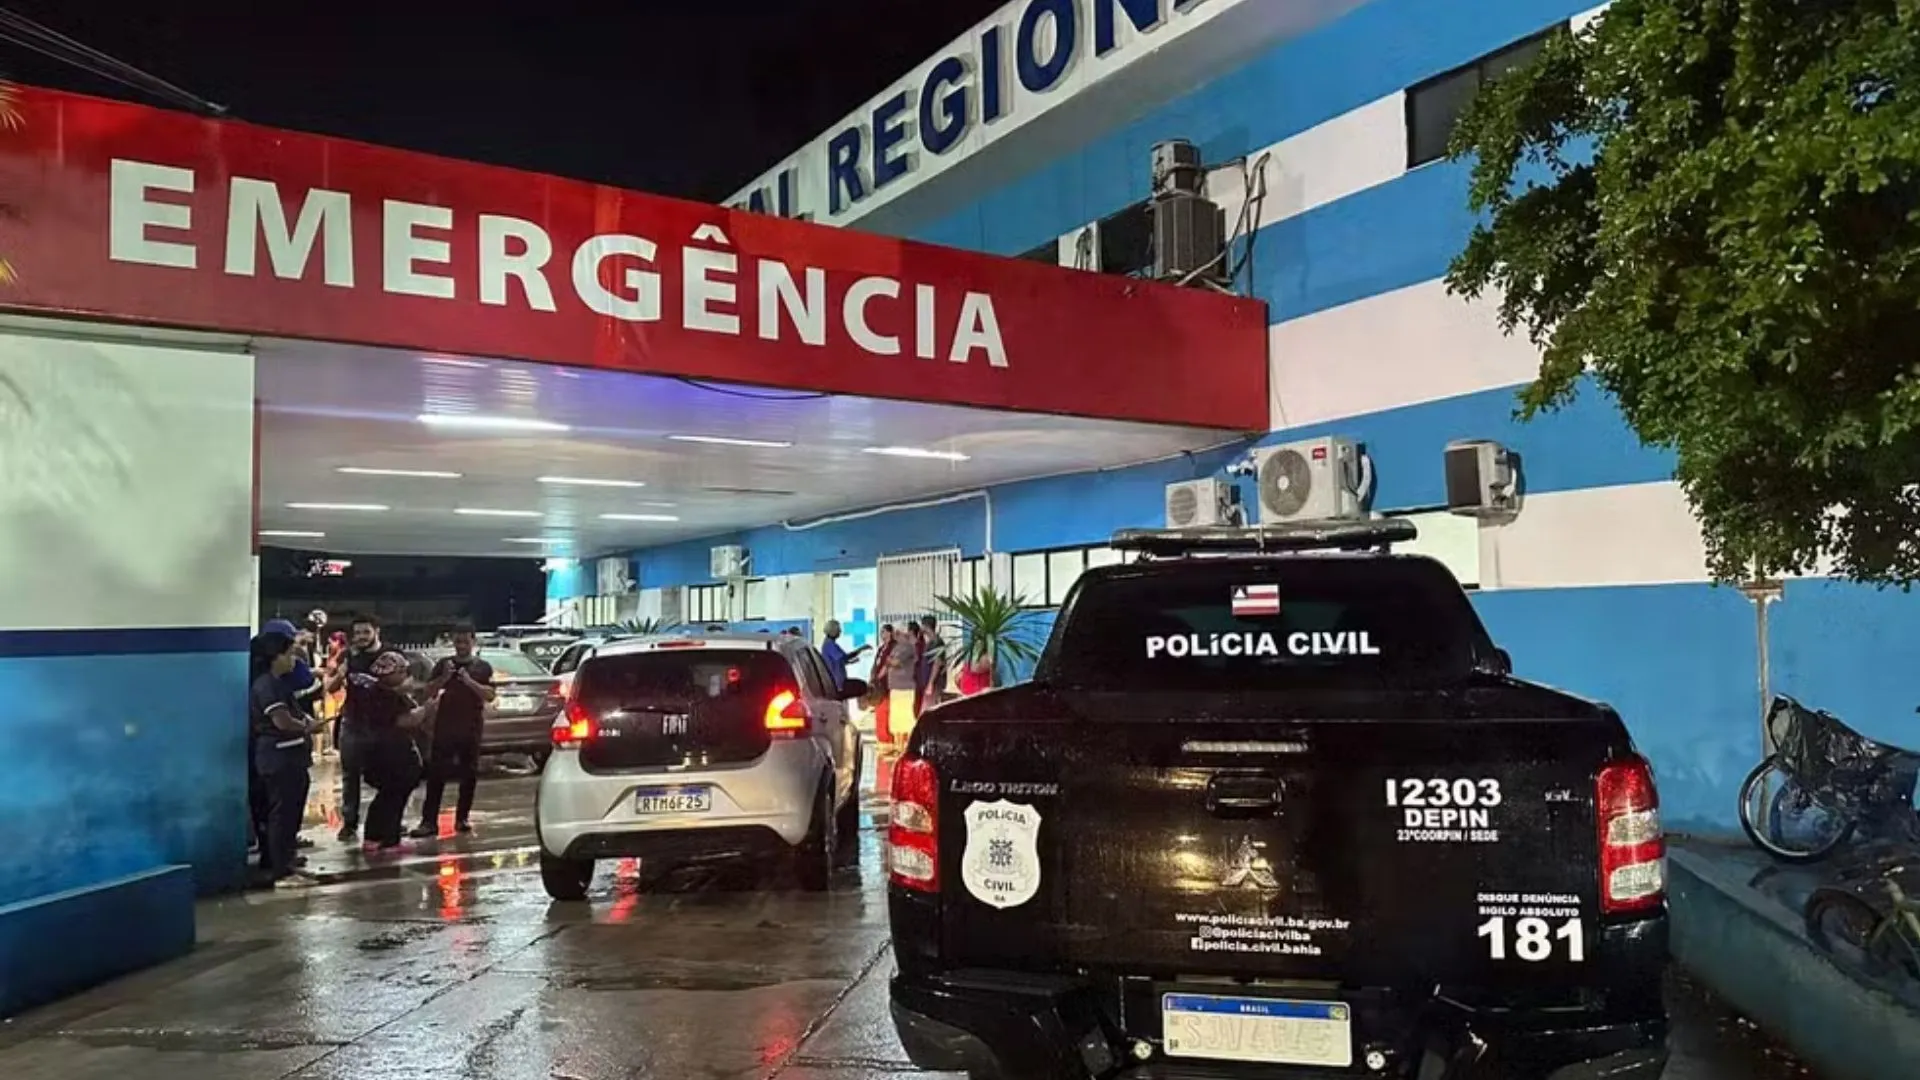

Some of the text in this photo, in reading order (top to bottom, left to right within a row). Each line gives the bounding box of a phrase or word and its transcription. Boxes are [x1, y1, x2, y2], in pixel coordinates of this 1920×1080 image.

[110, 158, 1009, 368] EMERGÊNCIA
[1287, 631, 1380, 655] CIVIL
[1404, 808, 1488, 828] DEPIN
[1470, 830, 1499, 842] SEDE
[984, 879, 1016, 892] CIVIL
[1478, 893, 1580, 904] DISQUE DENÚNCIA
[1479, 905, 1579, 917] SIGILO ABSOLUTO
[1478, 917, 1584, 962] 181
